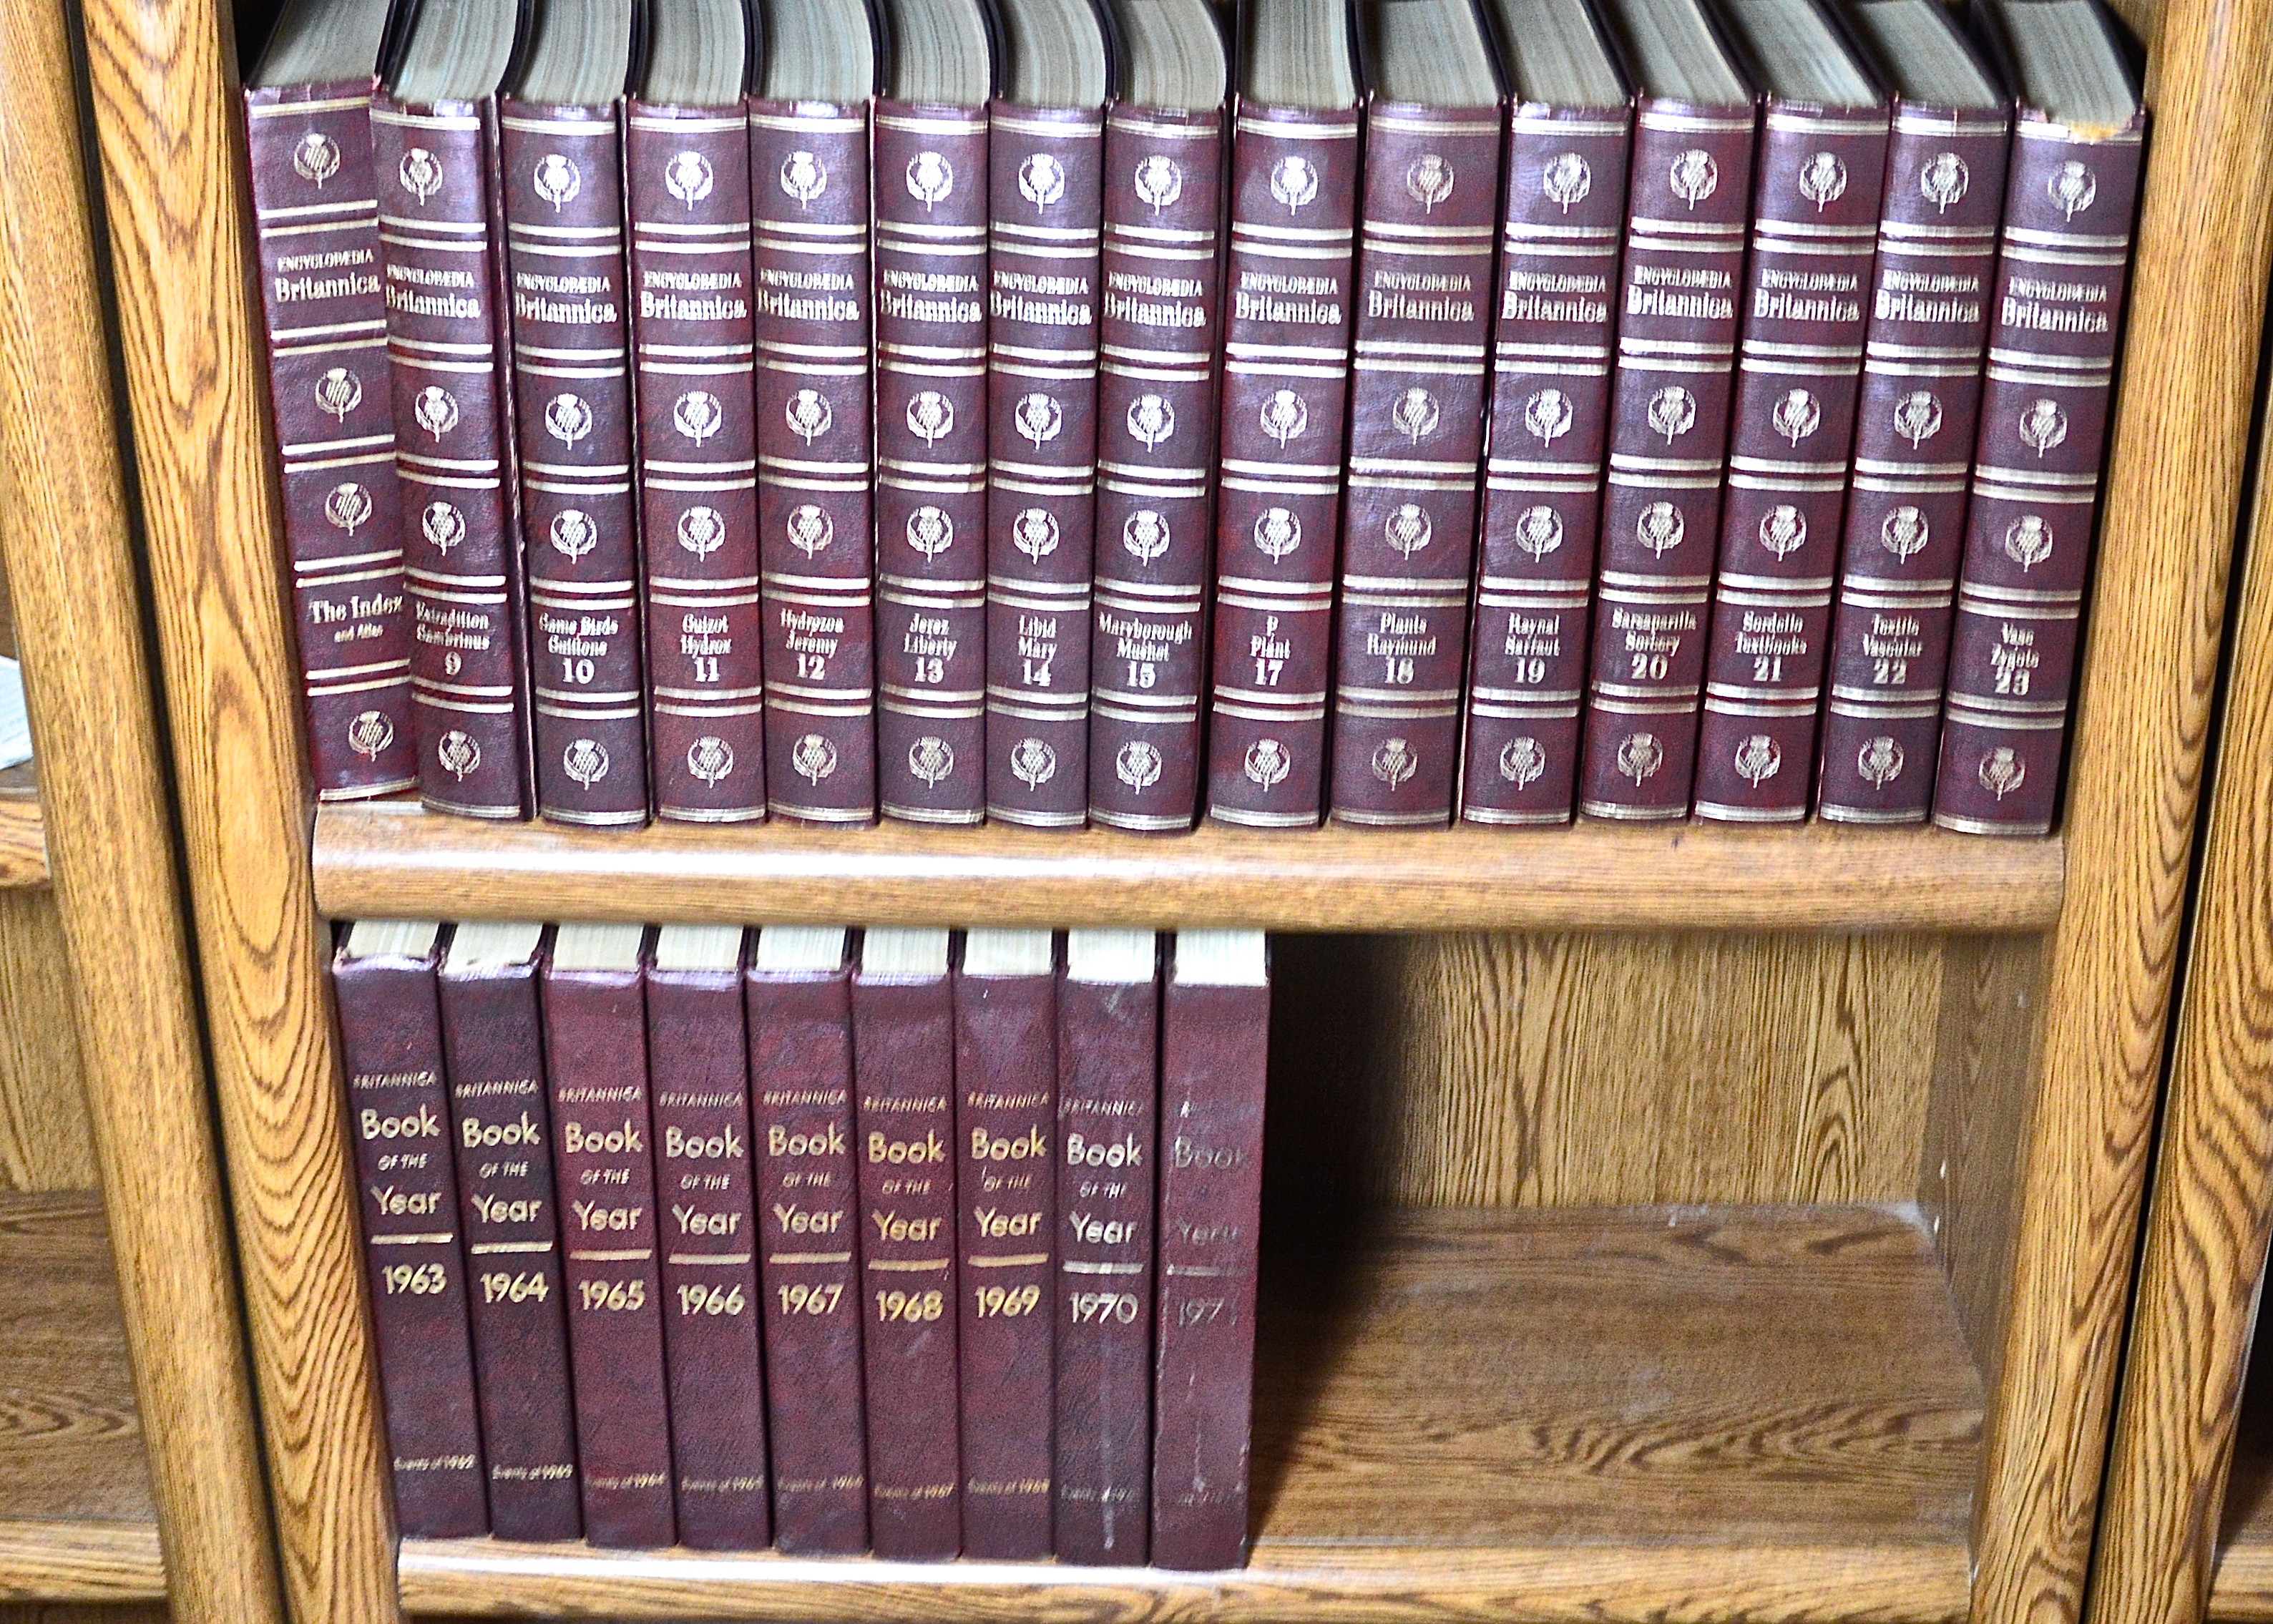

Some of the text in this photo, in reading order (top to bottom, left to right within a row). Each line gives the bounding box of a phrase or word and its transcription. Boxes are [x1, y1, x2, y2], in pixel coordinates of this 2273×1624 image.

[275, 273, 381, 302] Britannica
[386, 284, 482, 318] Britannica
[1626, 284, 1734, 319] Britannica
[514, 293, 617, 323] Britannica
[640, 290, 747, 321] Britannica
[758, 288, 859, 321] Britannica
[881, 290, 982, 323] Britannica
[990, 293, 1092, 326] Britannica
[1104, 292, 1206, 328] Britannica
[1235, 292, 1342, 325] Britannica
[1368, 290, 1474, 321] Britannica
[1502, 290, 1608, 323] Britannica
[1753, 288, 1860, 321] Britannica
[1874, 289, 1980, 323] Britannica
[2001, 296, 2108, 333] Britannica
[309, 592, 403, 624] The Index
[781, 608, 844, 633] Hydrozoa
[1612, 607, 1696, 632] Sarsaparilla
[581, 616, 619, 635] Birds
[683, 614, 728, 634] Guizot
[909, 613, 949, 634] Jerez
[1019, 615, 1056, 638] Libid
[1099, 612, 1192, 645] Maryborough
[1266, 615, 1279, 637] P
[1508, 612, 1560, 635] Raynal
[786, 630, 838, 659] Jeremy
[904, 634, 957, 660] Liberty
[1018, 637, 1057, 660] Mary
[1250, 635, 1291, 659] Plant
[445, 651, 462, 675] 9
[562, 657, 595, 684] 10
[694, 657, 720, 682] 11
[797, 654, 826, 680] 12
[914, 657, 944, 684] 13
[1022, 660, 1051, 687] 14
[1127, 661, 1156, 688] 15
[1255, 658, 1284, 685] 17
[1386, 657, 1414, 684] 18
[1515, 657, 1545, 684] 19
[1631, 652, 1668, 680] 20
[1753, 655, 1781, 682] 21
[1873, 658, 1907, 685] 22
[1995, 668, 2030, 695] 23
[353, 1071, 436, 1090] BRITANNICA
[455, 1080, 538, 1100] BRITANNICA
[559, 1086, 641, 1104] BRITANNICA
[660, 1092, 743, 1109] BRITANNICA
[763, 1090, 846, 1109] BRITANNICA
[864, 1095, 947, 1113] BRITANNICA
[361, 1104, 441, 1140] Book
[462, 1111, 540, 1148] Book
[565, 1119, 642, 1154] Book
[665, 1124, 744, 1159] Book
[768, 1122, 846, 1157] Book
[868, 1130, 945, 1165] Book
[972, 1124, 1047, 1160] Book
[1067, 1133, 1143, 1168] Book
[1175, 1135, 1248, 1169] Book
[378, 1153, 427, 1170] OF THE
[479, 1161, 528, 1179] OF THE
[580, 1168, 630, 1185] OF THE
[680, 1173, 730, 1190] OF THE
[783, 1171, 830, 1188] OF THE
[881, 1178, 931, 1195] OF THE
[984, 1174, 1032, 1192] OF THE
[370, 1186, 442, 1215] Year
[471, 1193, 542, 1223] Year
[572, 1200, 642, 1231] Year
[673, 1203, 741, 1236] Year
[773, 1203, 844, 1234] Year
[871, 1210, 942, 1242] Year
[974, 1206, 1042, 1238] Year
[1070, 1210, 1137, 1245] Year
[382, 1263, 448, 1296] 1963
[481, 1271, 549, 1303] 1964
[579, 1280, 645, 1311] 1965
[678, 1284, 746, 1316] 1966
[778, 1283, 844, 1315] 1967
[876, 1291, 944, 1323] 1968
[974, 1285, 1040, 1318] 1969
[1070, 1291, 1138, 1324] 1970
